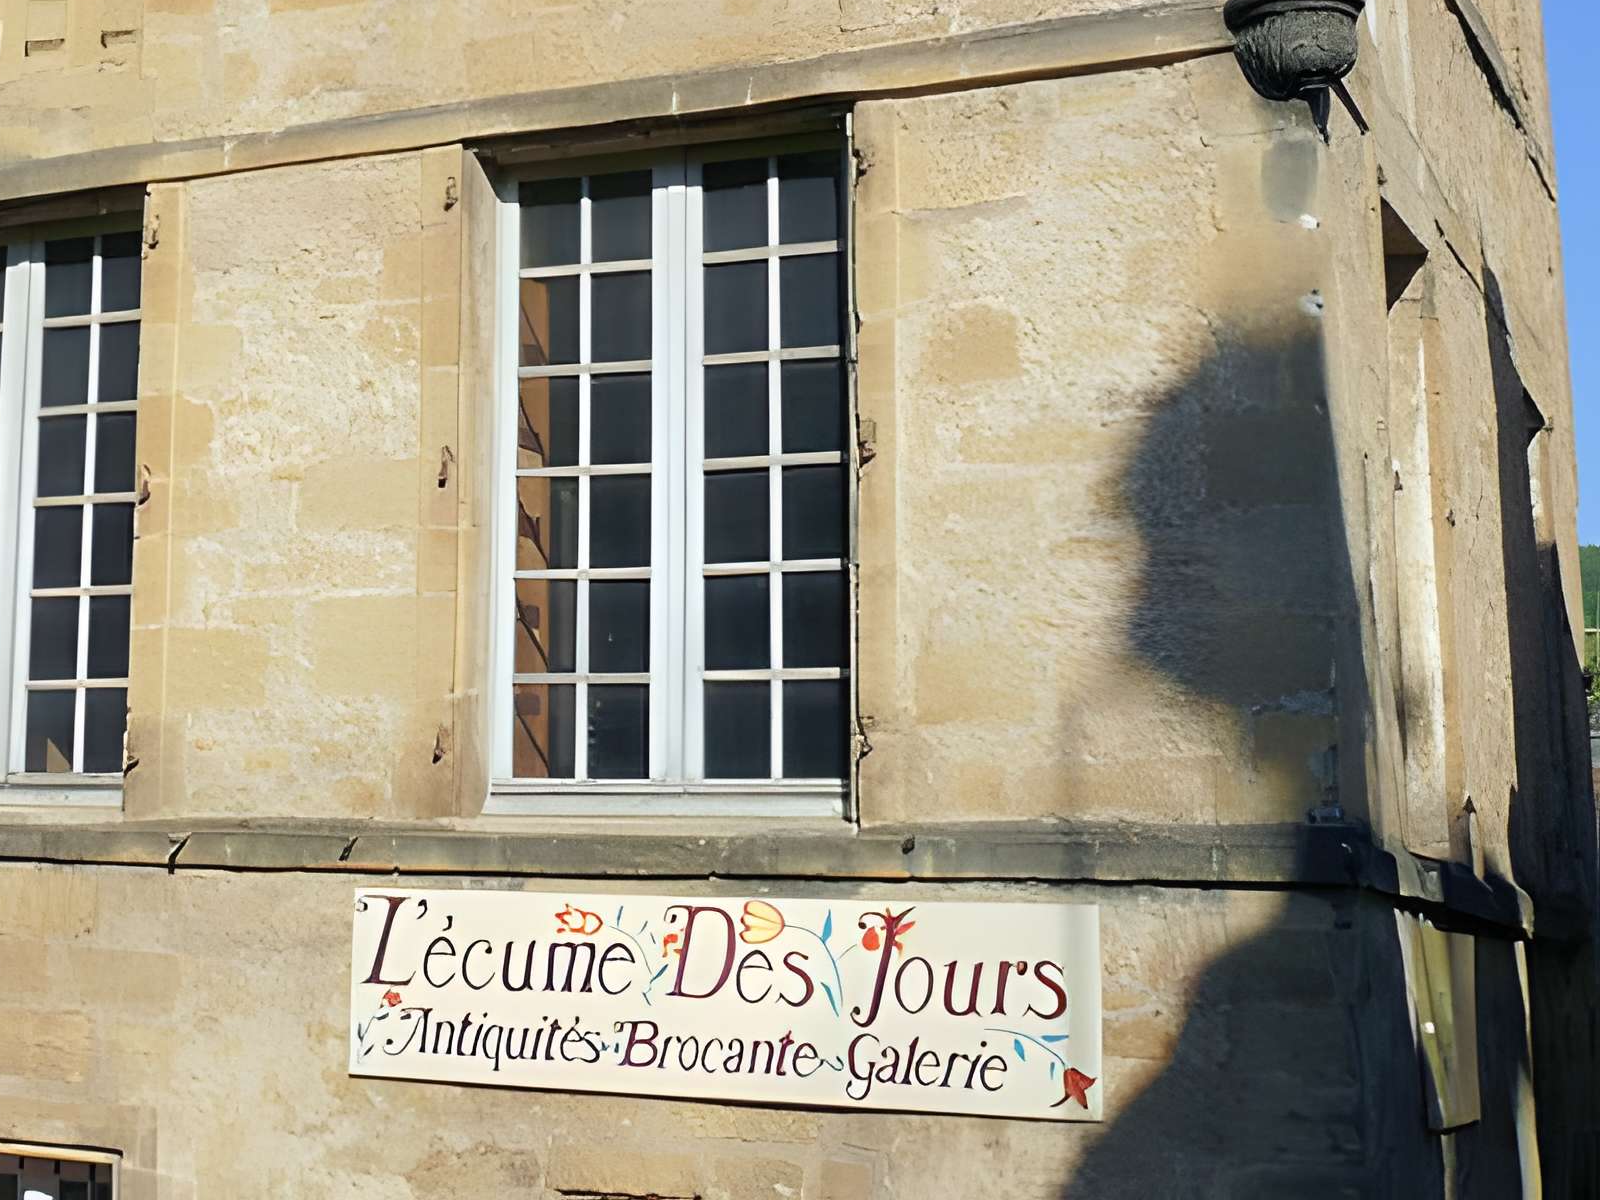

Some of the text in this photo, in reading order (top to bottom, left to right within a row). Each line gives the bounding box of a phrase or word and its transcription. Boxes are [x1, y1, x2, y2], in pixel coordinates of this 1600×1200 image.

[664, 904, 815, 1007] Des
[850, 906, 1068, 1028] Jours
[383, 1007, 1008, 1101] Antiquités Brocante Galerie
